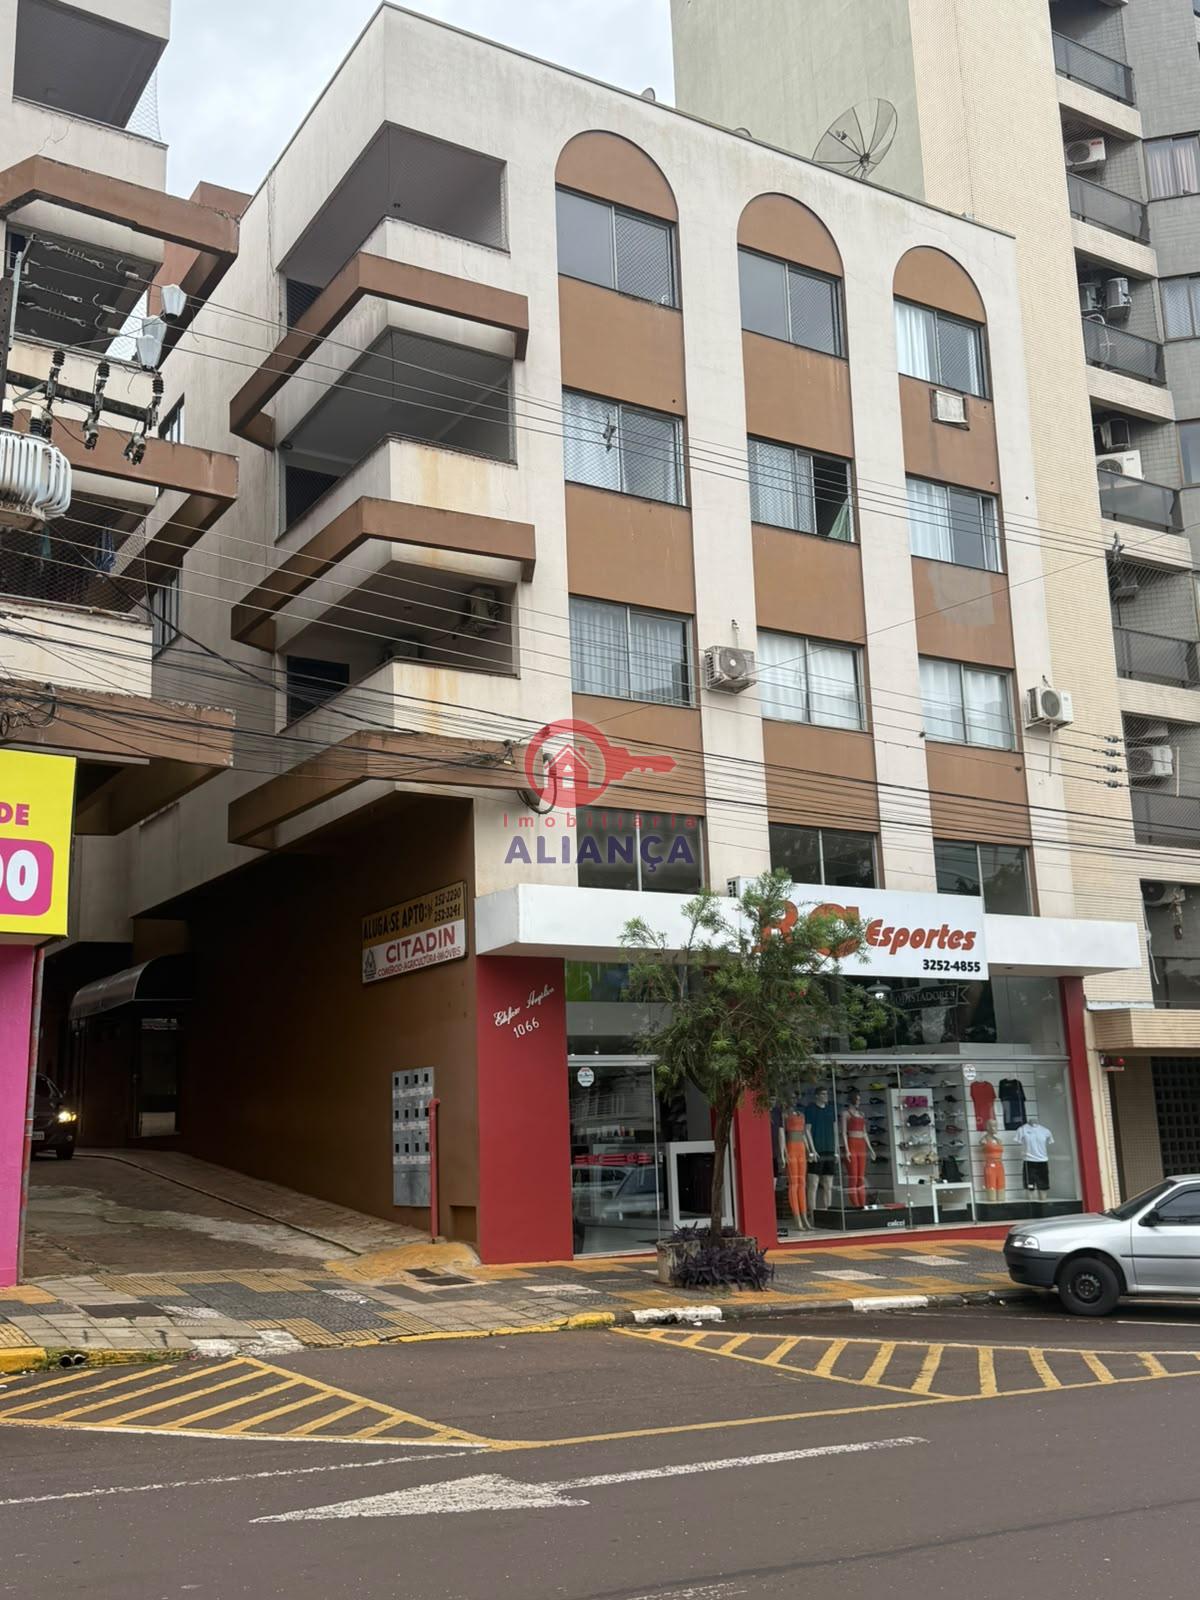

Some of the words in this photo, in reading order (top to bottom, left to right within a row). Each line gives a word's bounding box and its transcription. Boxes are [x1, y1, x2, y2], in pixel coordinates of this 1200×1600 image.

[0, 849, 39, 903] 0
[386, 926, 456, 963] CITADIN
[865, 919, 976, 955] Esportes
[923, 959, 981, 973] 3252-4855
[513, 1017, 540, 1038] 1066
